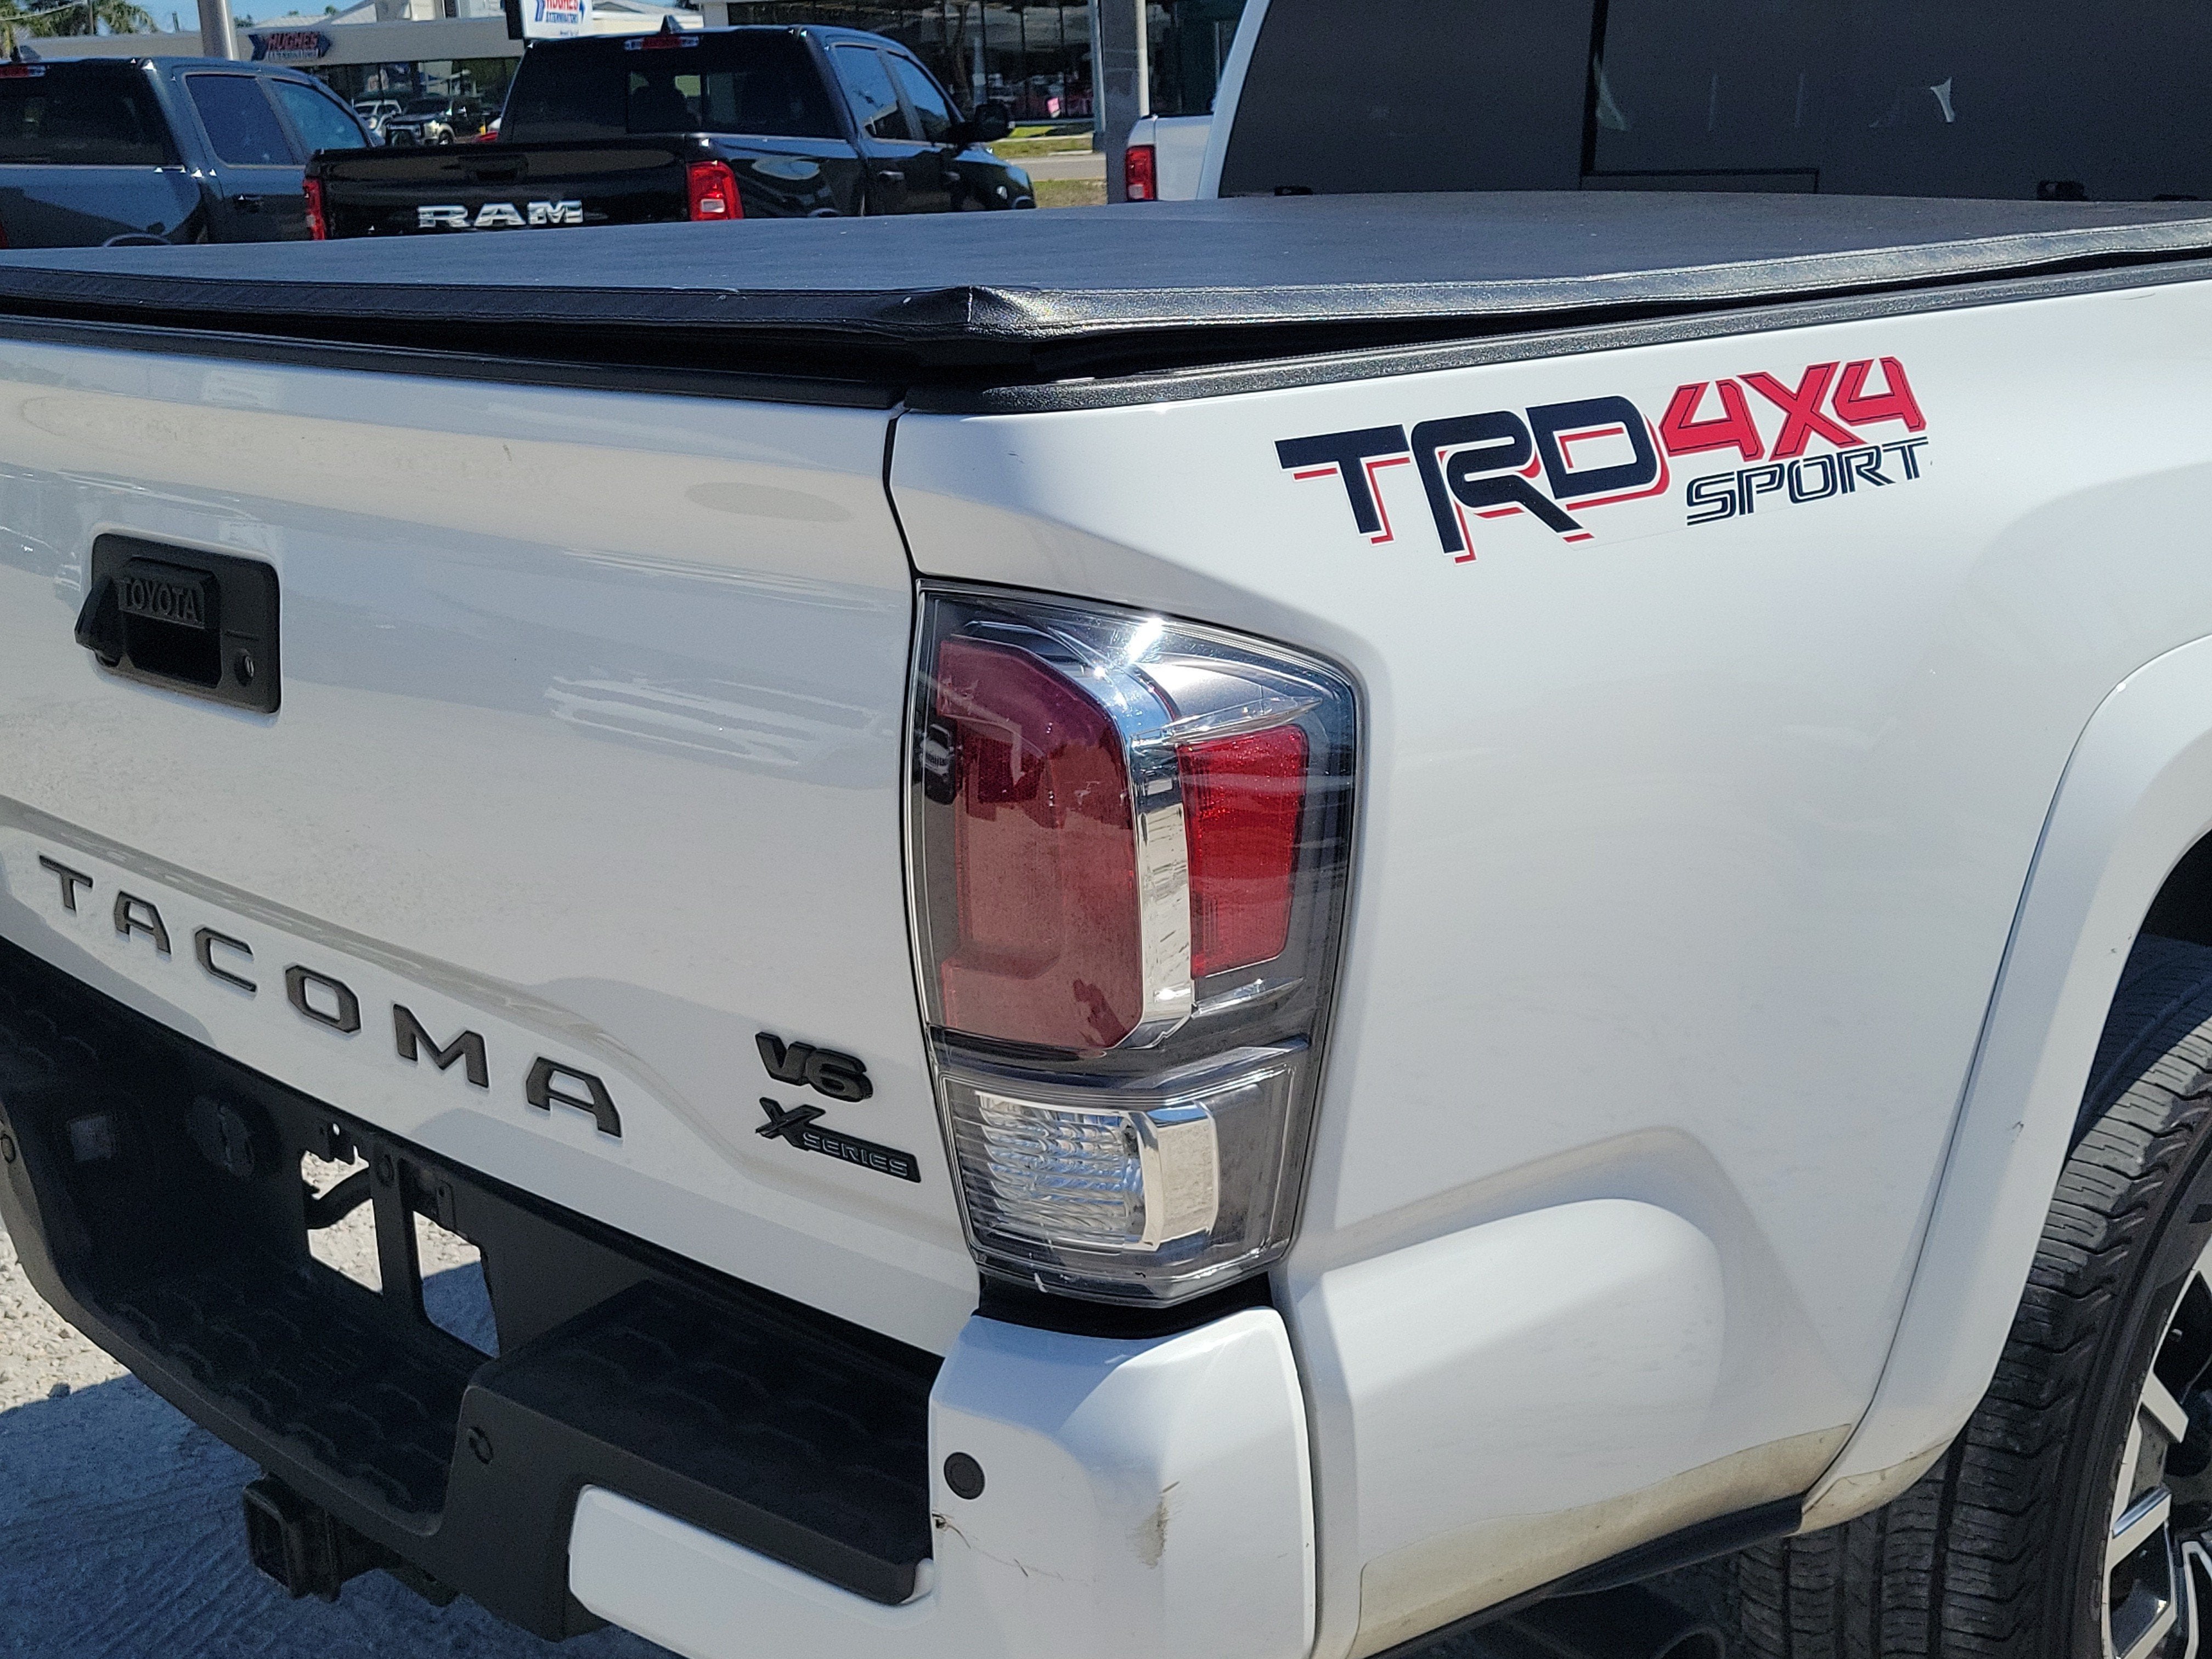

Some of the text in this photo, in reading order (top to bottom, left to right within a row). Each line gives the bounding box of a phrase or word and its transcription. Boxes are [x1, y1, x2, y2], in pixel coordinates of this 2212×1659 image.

[417, 200, 584, 229] RAM
[1274, 395, 1670, 565] TRD
[1686, 436, 1929, 527] SPORT
[122, 576, 199, 621] TOYOTA
[38, 854, 622, 1138] TACOMA
[755, 1031, 873, 1103] V6
[803, 1131, 909, 1177] SERIES
